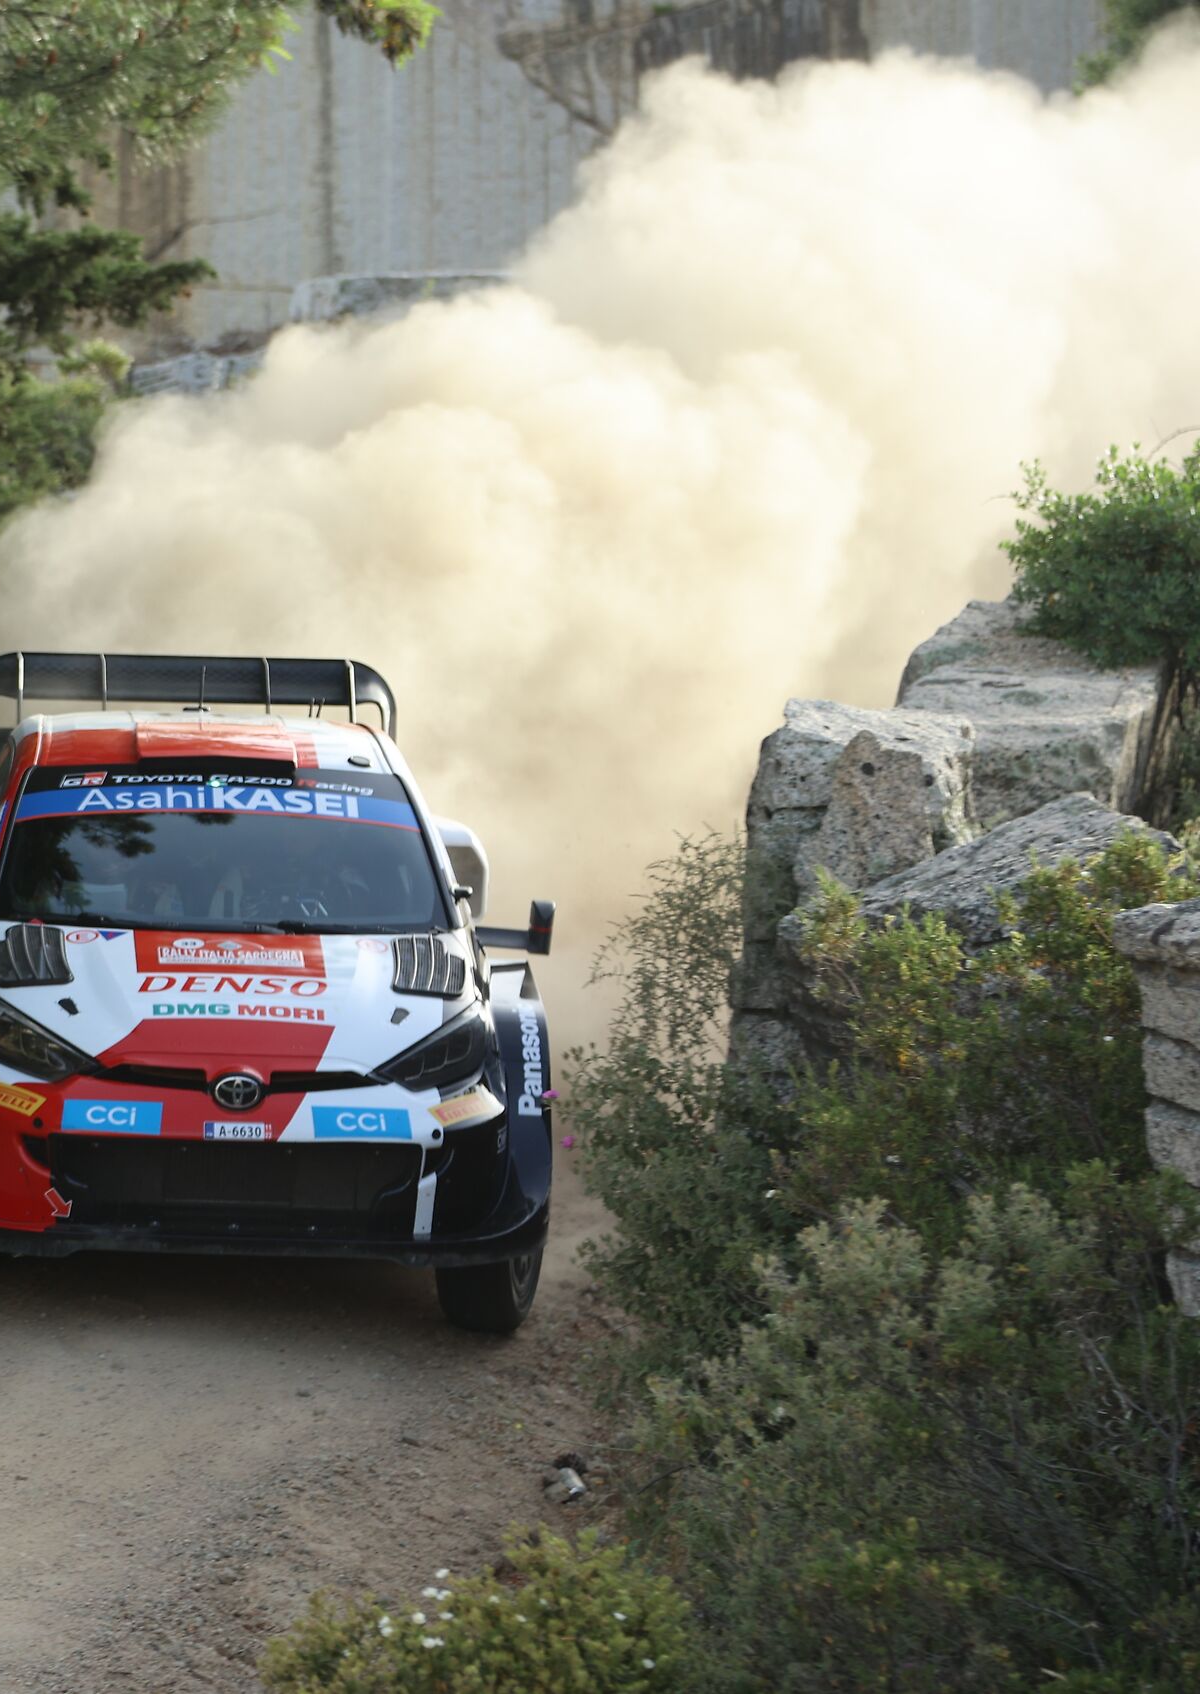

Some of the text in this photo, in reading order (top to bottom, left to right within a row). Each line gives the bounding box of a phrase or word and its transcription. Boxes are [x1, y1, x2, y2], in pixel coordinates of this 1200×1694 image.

[63, 774, 374, 796] GR TOYOTA GAZOO Racing
[162, 947, 197, 958] RALLY
[199, 950, 236, 960] ITALIA
[237, 950, 300, 962] SARDEGNA
[137, 976, 328, 997] DENSO
[152, 1003, 325, 1021] DMG MORI
[219, 1126, 262, 1138] A-6630
